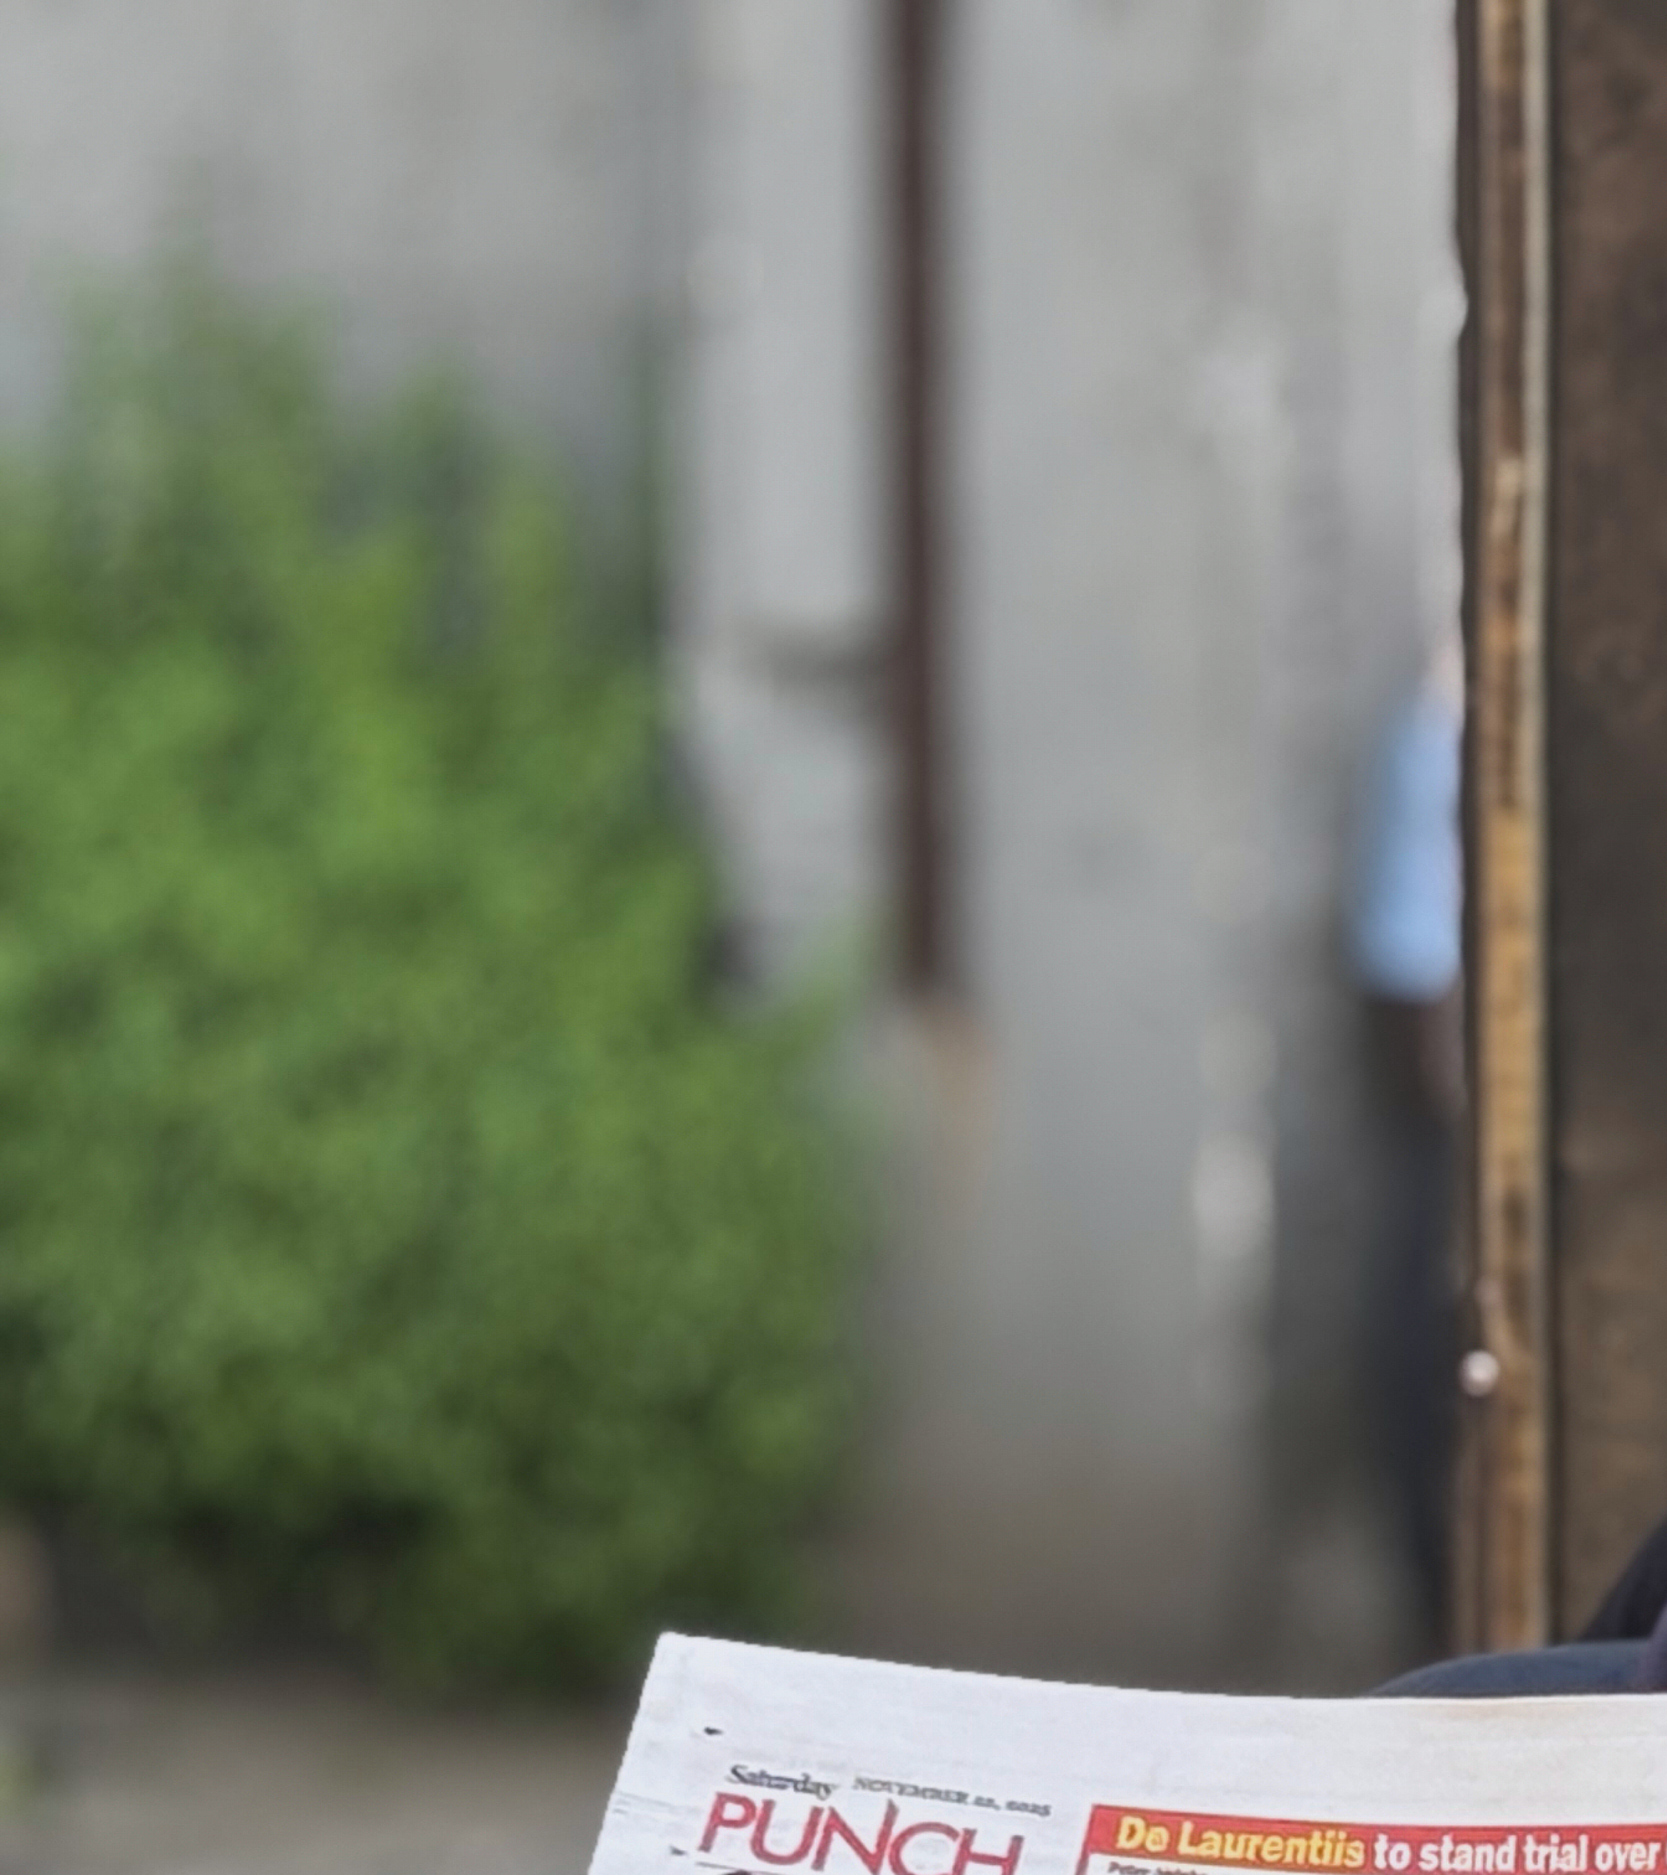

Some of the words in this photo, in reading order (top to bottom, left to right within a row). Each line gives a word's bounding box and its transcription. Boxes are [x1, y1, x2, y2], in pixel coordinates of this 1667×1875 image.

[728, 1764, 836, 1799] Saturday
[1116, 1816, 1169, 1853] De
[1177, 1820, 1365, 1868] Laurentiis
[1374, 1834, 1411, 1868] to
[1418, 1836, 1515, 1873] stand
[1524, 1834, 1589, 1872] trial
[1595, 1840, 1660, 1872] over
